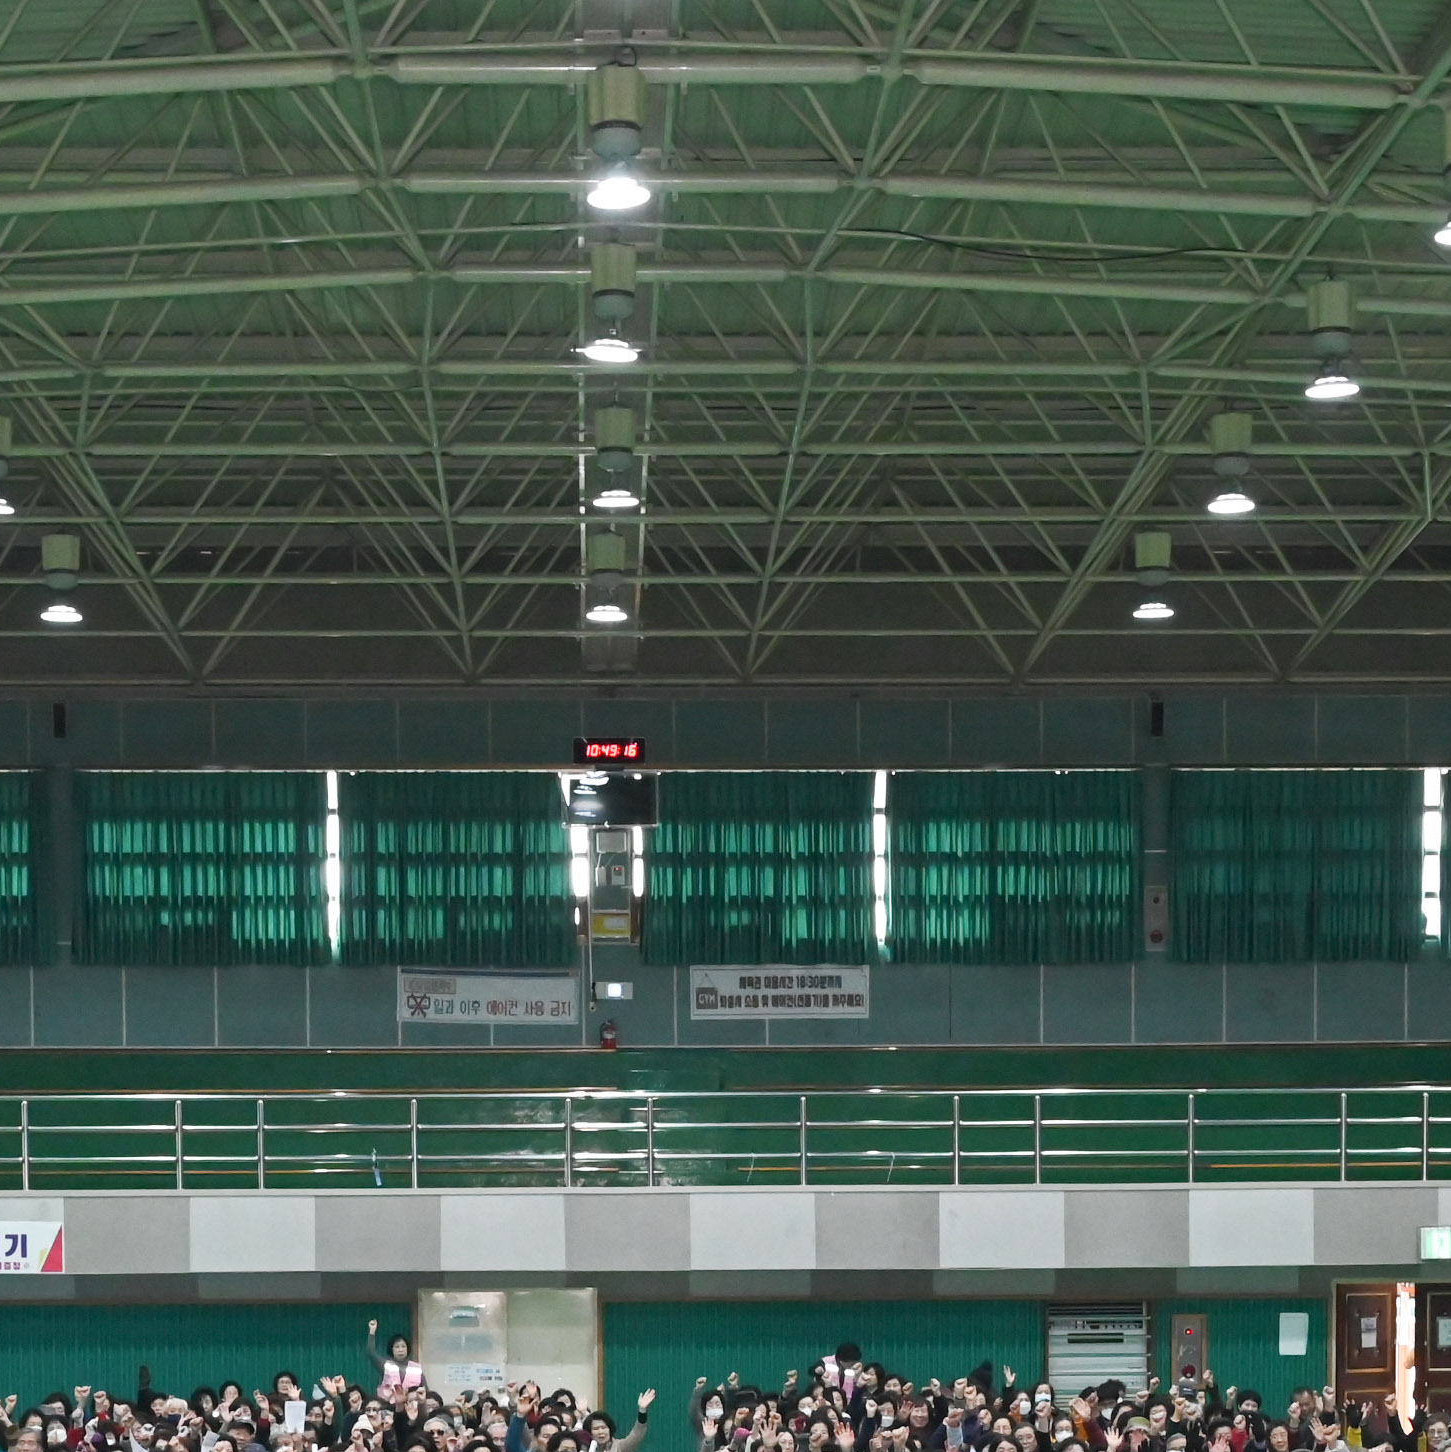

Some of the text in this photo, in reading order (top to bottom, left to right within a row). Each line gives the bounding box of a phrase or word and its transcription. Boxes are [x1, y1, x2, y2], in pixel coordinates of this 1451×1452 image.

[586, 744, 638, 758] 10:49:16
[433, 998, 572, 1017] 일과 이후 에어컨 사용 금지
